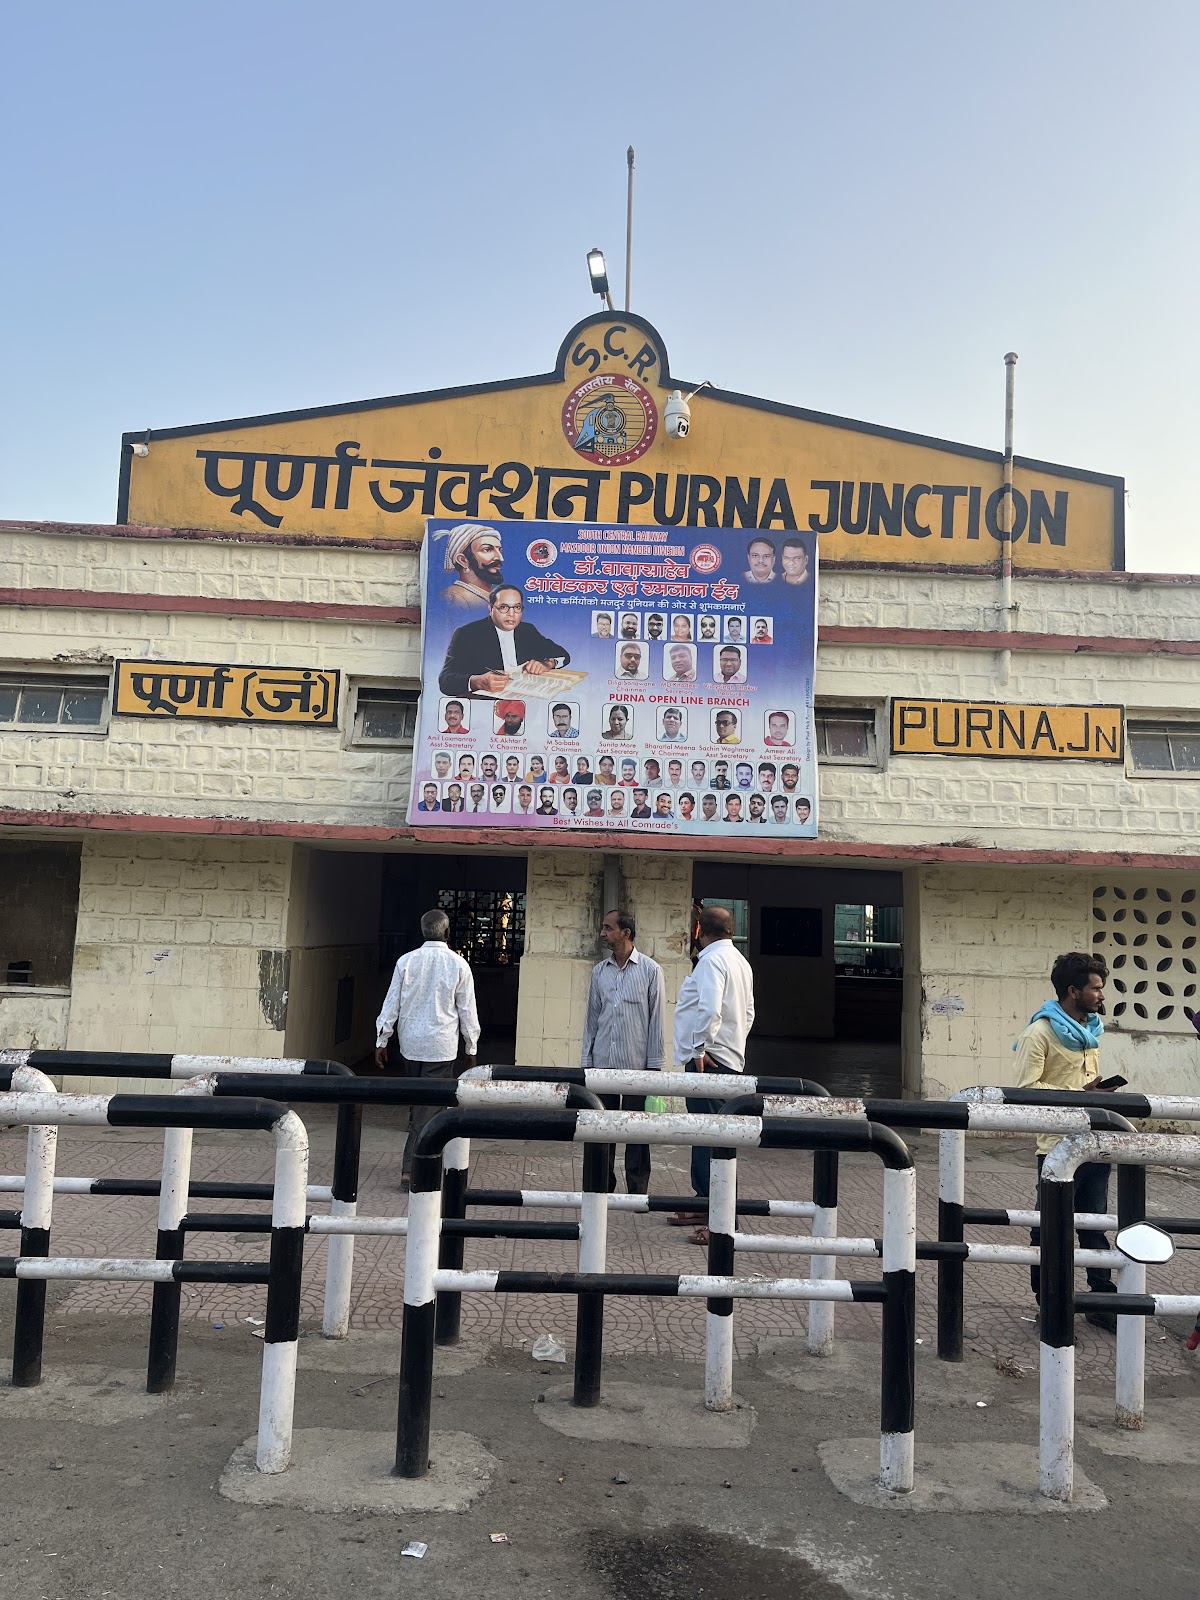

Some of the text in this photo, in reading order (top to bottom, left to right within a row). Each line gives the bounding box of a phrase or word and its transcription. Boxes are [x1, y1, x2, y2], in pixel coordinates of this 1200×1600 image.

[571, 325, 657, 383] S.C.R.
[575, 376, 641, 398] भारतीय रेल
[196, 441, 610, 528] पूर्णा जंक्शन
[616, 472, 1069, 546] PURNA JUNCTION
[578, 529, 668, 542] SOUTH CENTRAL RAILWAY
[560, 542, 596, 554] MAZDOOR
[597, 543, 622, 554] UNION
[622, 544, 652, 556] NANDED
[653, 545, 685, 556] DIVISION
[611, 576, 638, 598] एवं
[640, 580, 708, 598] रमजान
[711, 578, 740, 600] ईद
[527, 595, 544, 604] सभी
[546, 595, 558, 605] रेल
[657, 598, 669, 609] की
[671, 600, 687, 610] ओर
[688, 600, 697, 610] से
[130, 667, 234, 715] पूर्णा
[609, 693, 750, 706] PURNA OPEN LINE BRANCH
[553, 817, 679, 830] Best Wishes to All Comrade's
